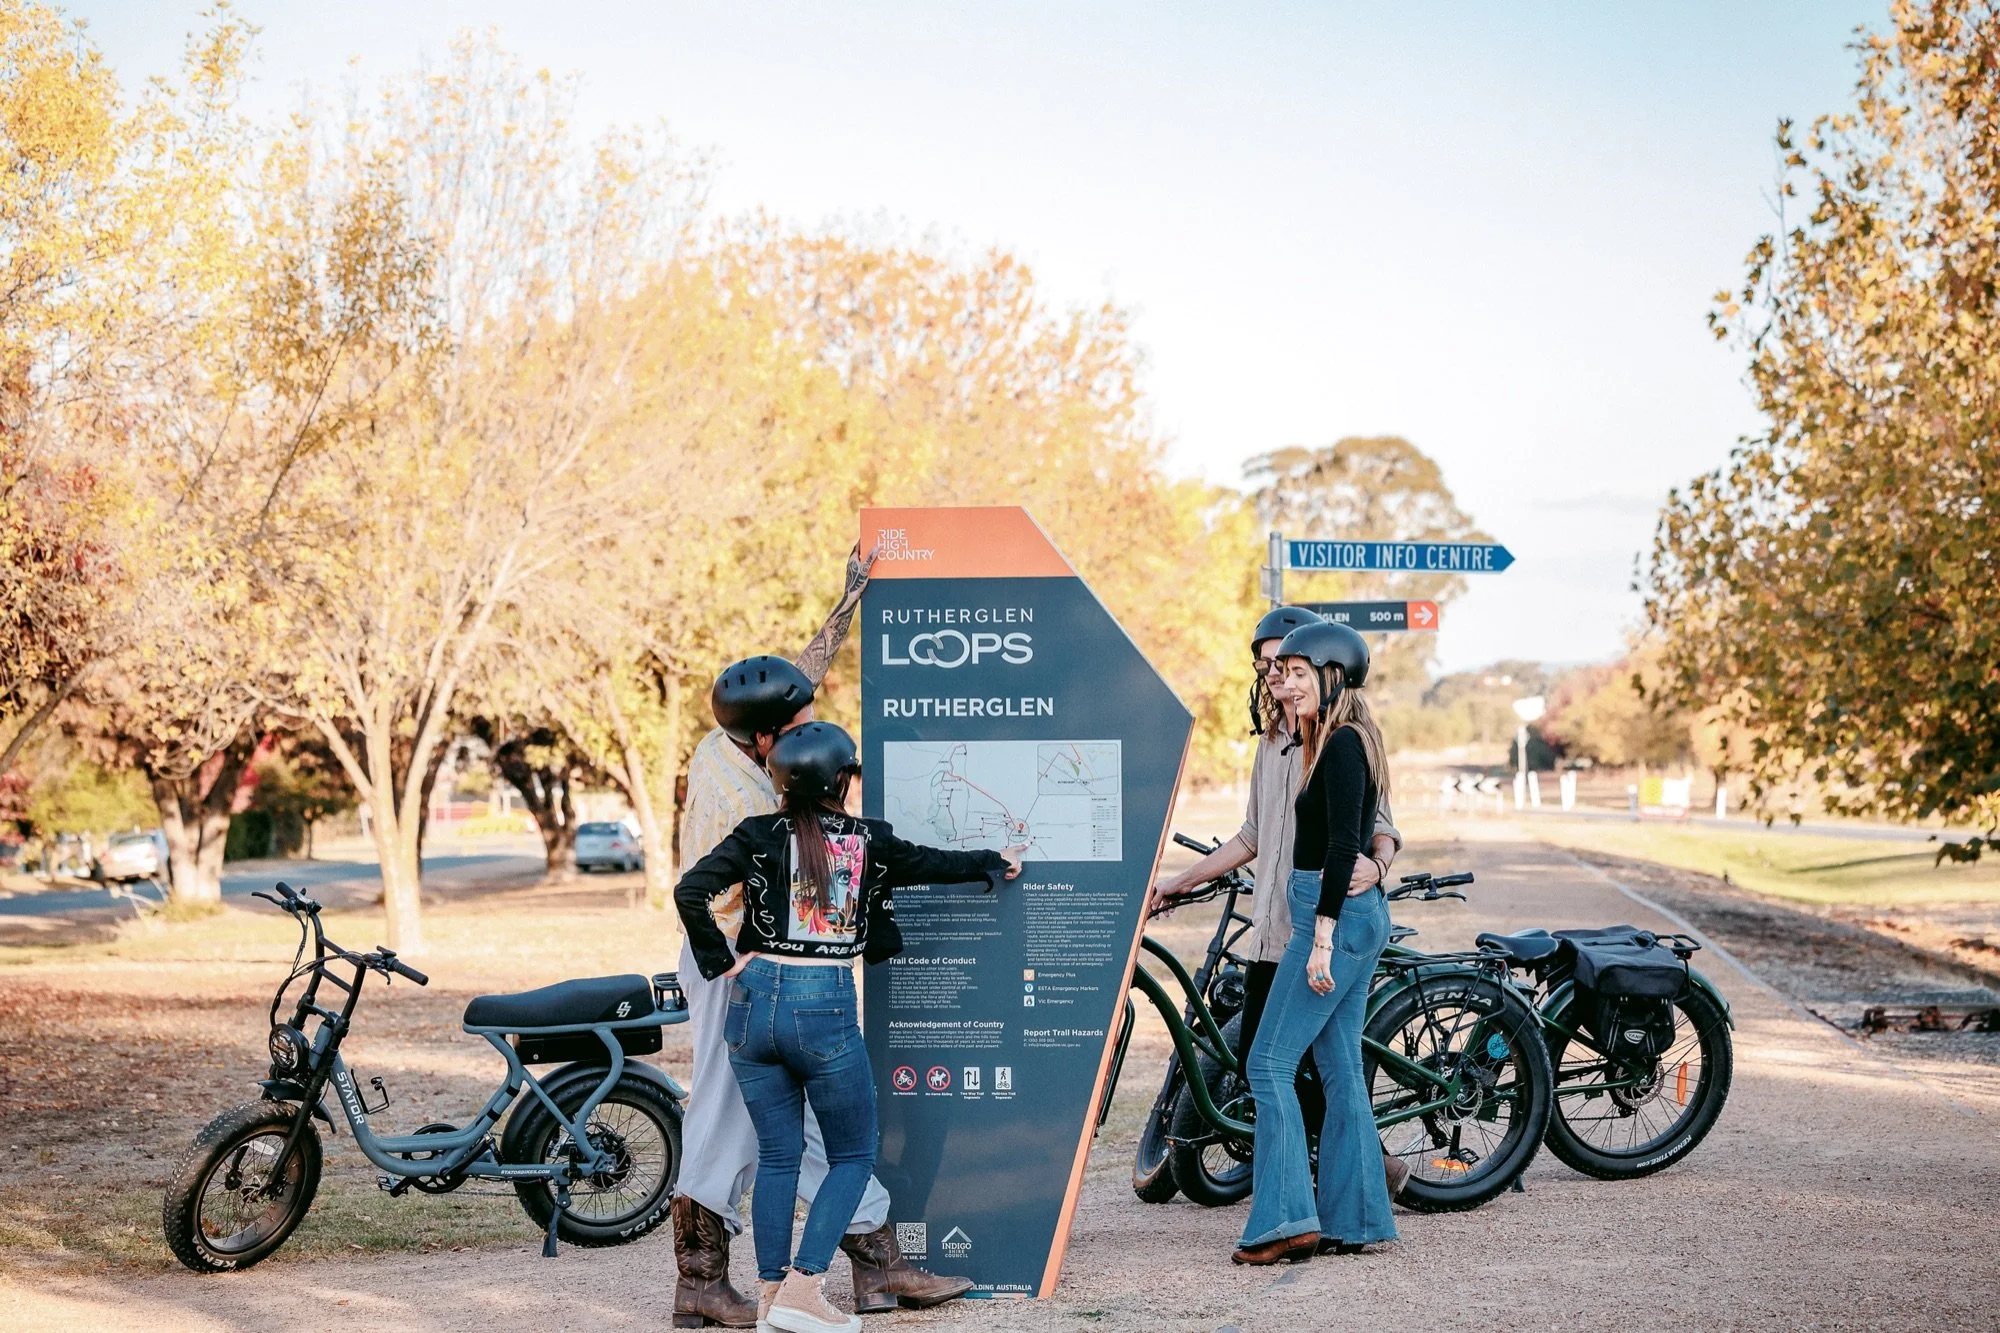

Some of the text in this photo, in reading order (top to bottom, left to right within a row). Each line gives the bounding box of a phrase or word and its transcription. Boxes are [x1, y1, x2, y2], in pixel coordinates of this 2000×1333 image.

[878, 529, 908, 539] RIDE
[878, 537, 908, 550] HIGH
[877, 550, 936, 560] COUNTRY
[1298, 544, 1493, 570] VISITOR INFO CENTRE
[882, 608, 1034, 624] RUTHERGLEN
[1370, 612, 1391, 622] 500
[882, 629, 1034, 669] LOOPS
[883, 697, 1054, 717] RUTHERGLEN
[1048, 883, 1074, 892] Safety
[763, 941, 804, 952] YOU
[815, 944, 849, 954] ARE
[889, 1020, 1004, 1029] Acknowledgement of Country
[1024, 1029, 1050, 1037] Report
[337, 1072, 364, 1125] STATOR
[620, 1190, 674, 1238] ENDA
[192, 1234, 236, 1268] KENDA
